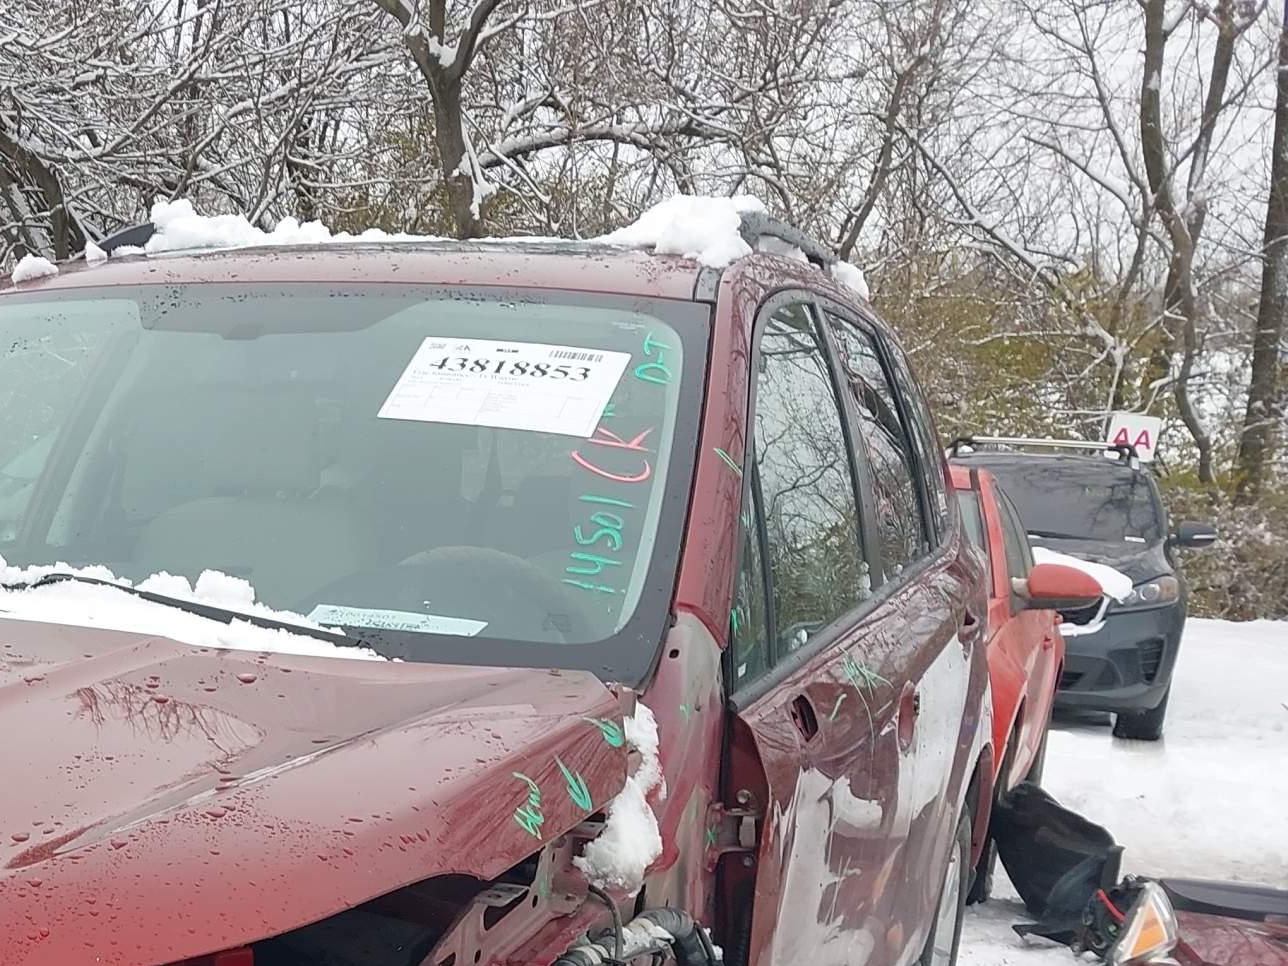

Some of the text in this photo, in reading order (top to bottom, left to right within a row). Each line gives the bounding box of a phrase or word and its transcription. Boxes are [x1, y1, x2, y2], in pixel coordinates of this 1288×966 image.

[429, 356, 591, 382] 43818853
[1113, 427, 1151, 450] AA
[561, 495, 635, 594] 14501
